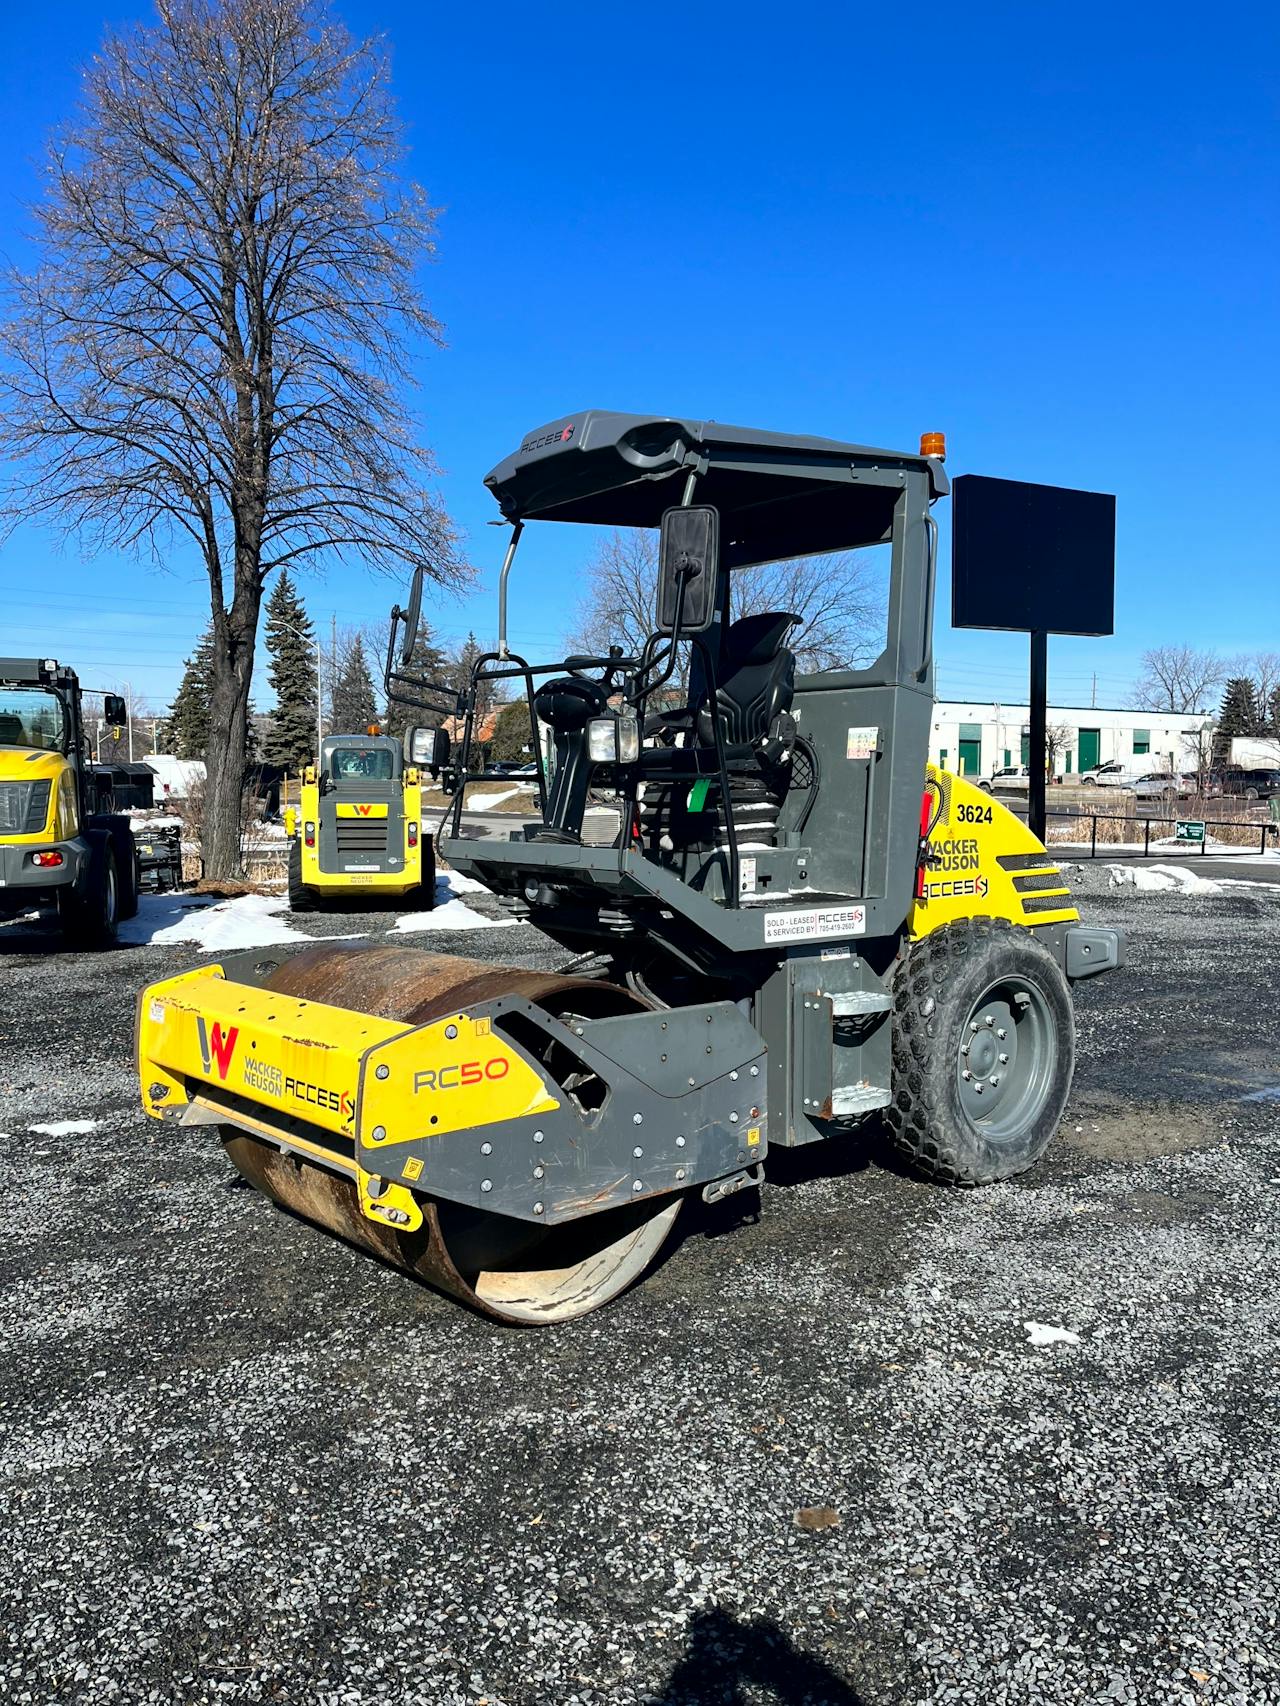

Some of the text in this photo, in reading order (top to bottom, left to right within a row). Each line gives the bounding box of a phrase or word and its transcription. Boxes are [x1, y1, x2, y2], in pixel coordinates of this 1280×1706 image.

[957, 804, 993, 824] 3624
[766, 919, 785, 928] SOLD
[789, 916, 815, 926] LEASED
[773, 927, 805, 936] SERVICED
[244, 1056, 283, 1083] WACKER
[414, 1057, 510, 1094] RC50
[243, 1070, 283, 1098] NEUSON
